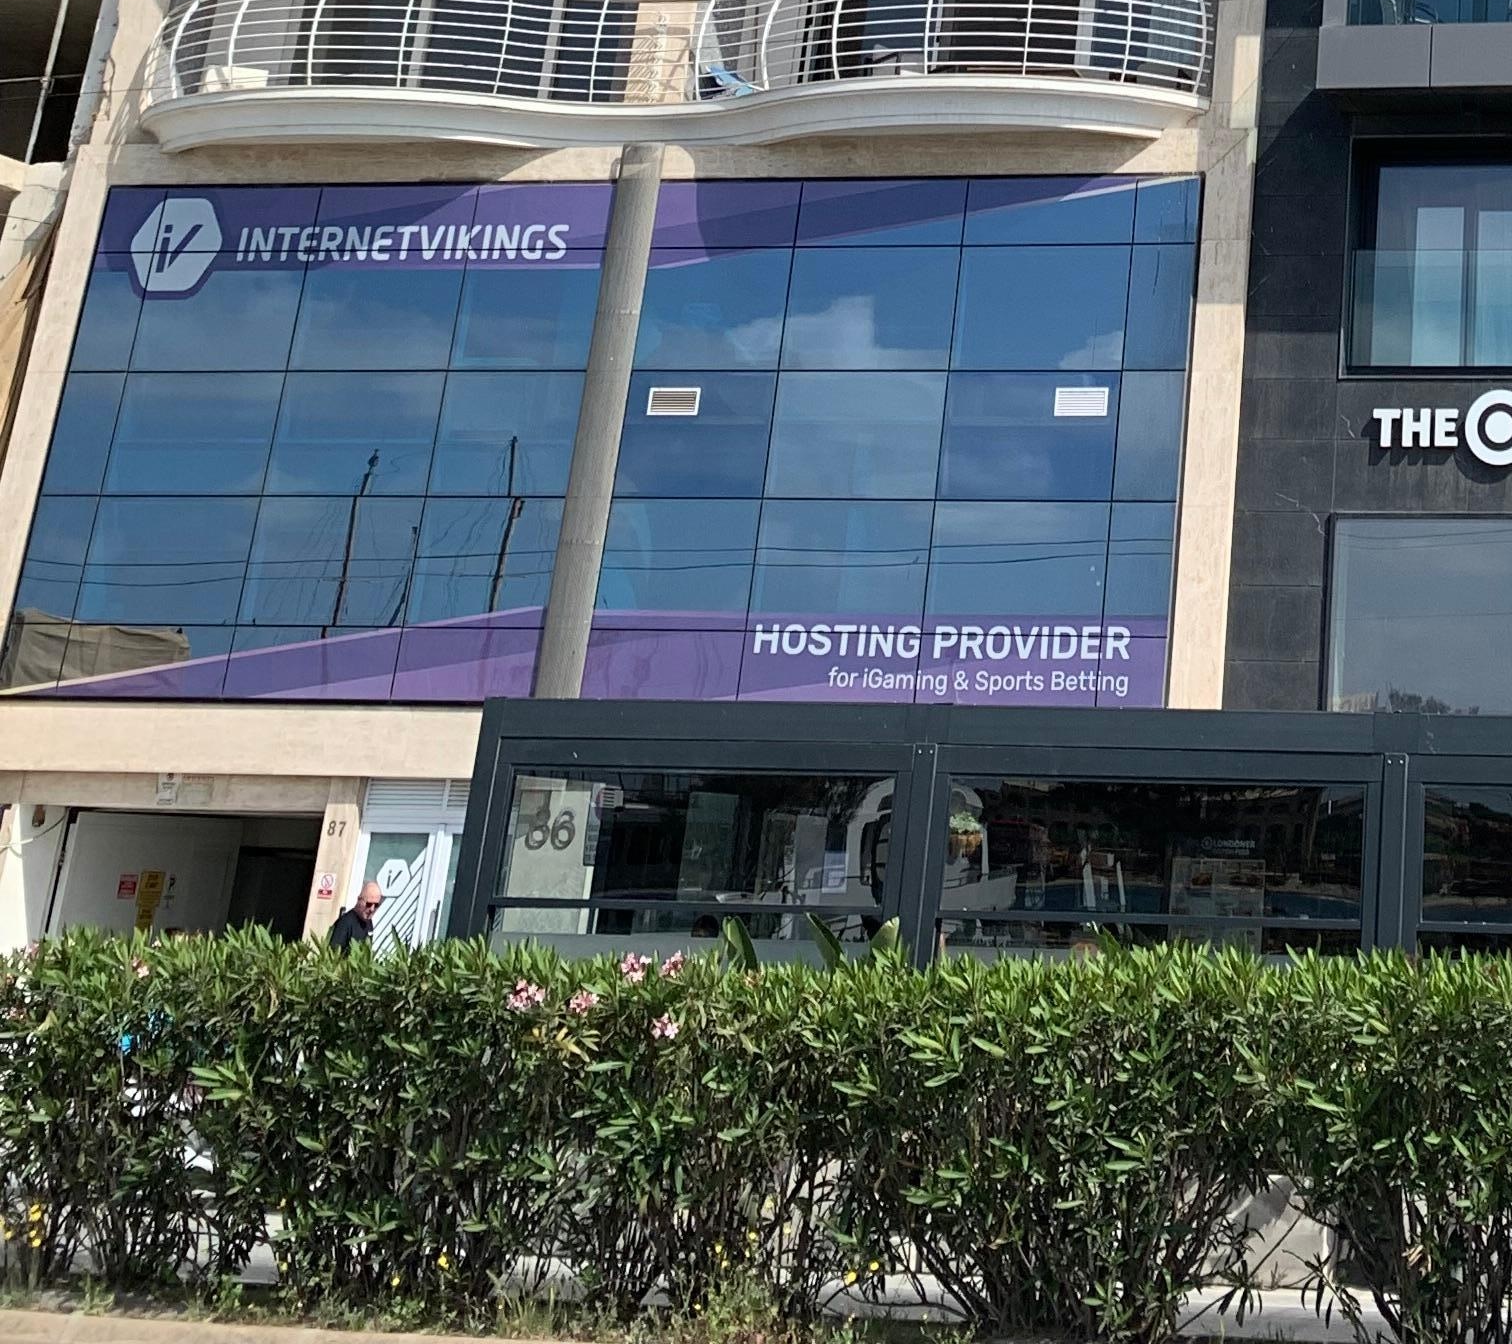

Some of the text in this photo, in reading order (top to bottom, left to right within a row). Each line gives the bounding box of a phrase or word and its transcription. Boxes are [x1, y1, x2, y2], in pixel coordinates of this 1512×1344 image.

[236, 223, 570, 262] INTERNETVIKINGS
[1372, 407, 1459, 448] THE
[753, 623, 1131, 661] HOSTING PROVIDER
[828, 666, 1129, 697] for iGaming & Sports Betting
[327, 820, 347, 838] 87
